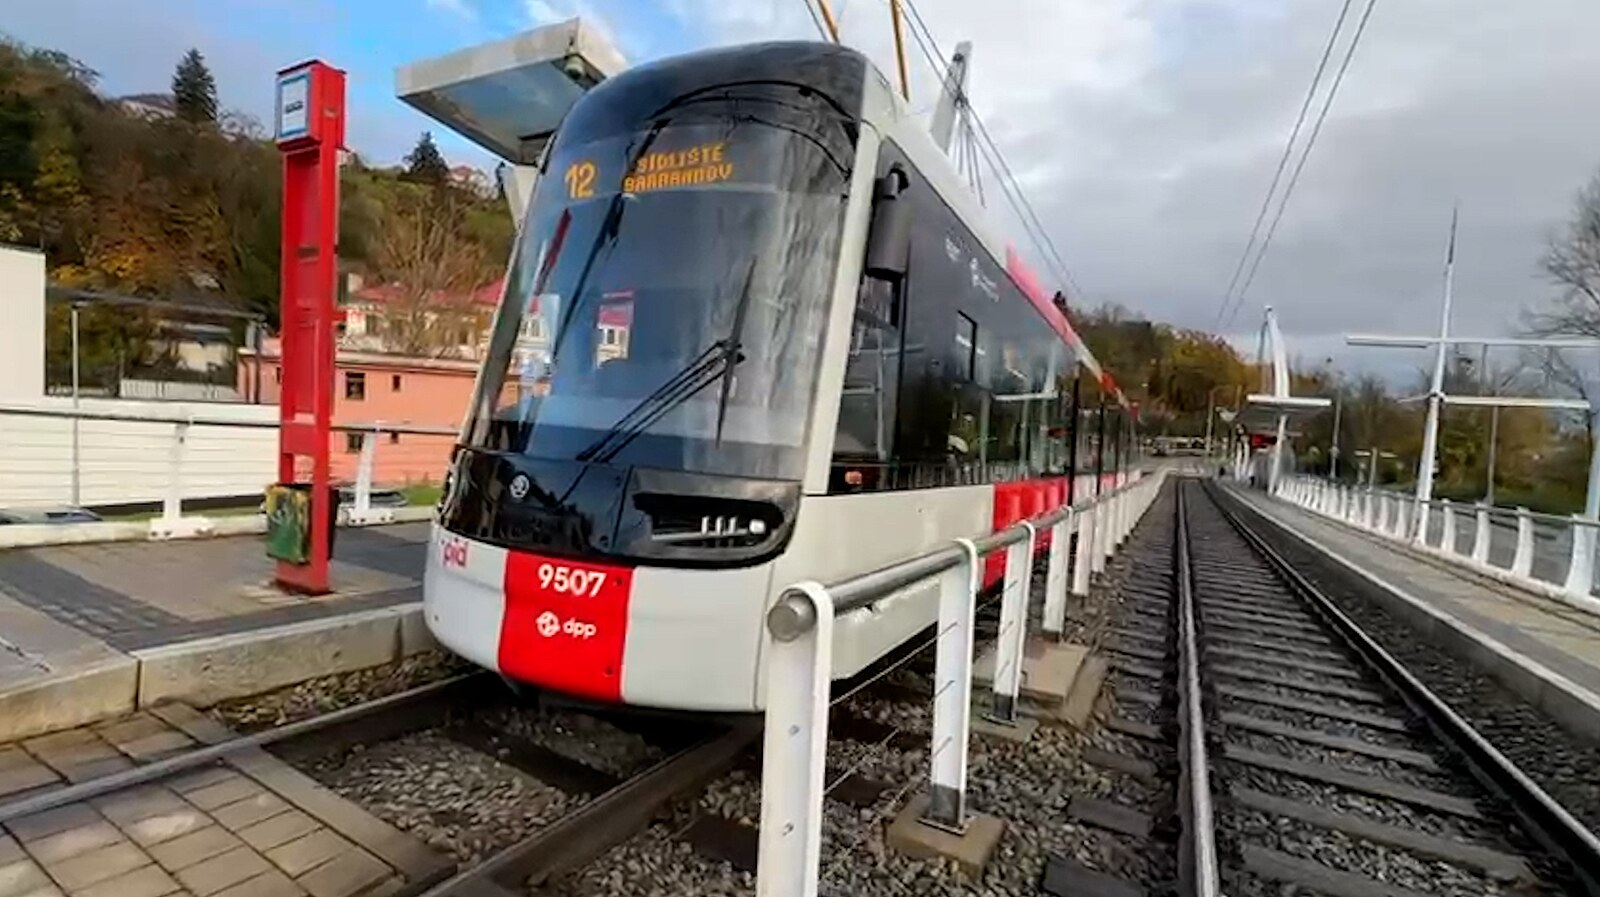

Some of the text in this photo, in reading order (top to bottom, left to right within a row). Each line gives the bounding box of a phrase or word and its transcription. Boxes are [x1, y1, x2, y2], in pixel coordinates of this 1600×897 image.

[565, 161, 596, 199] 12
[538, 563, 607, 598] 9507
[563, 617, 597, 640] dpp
